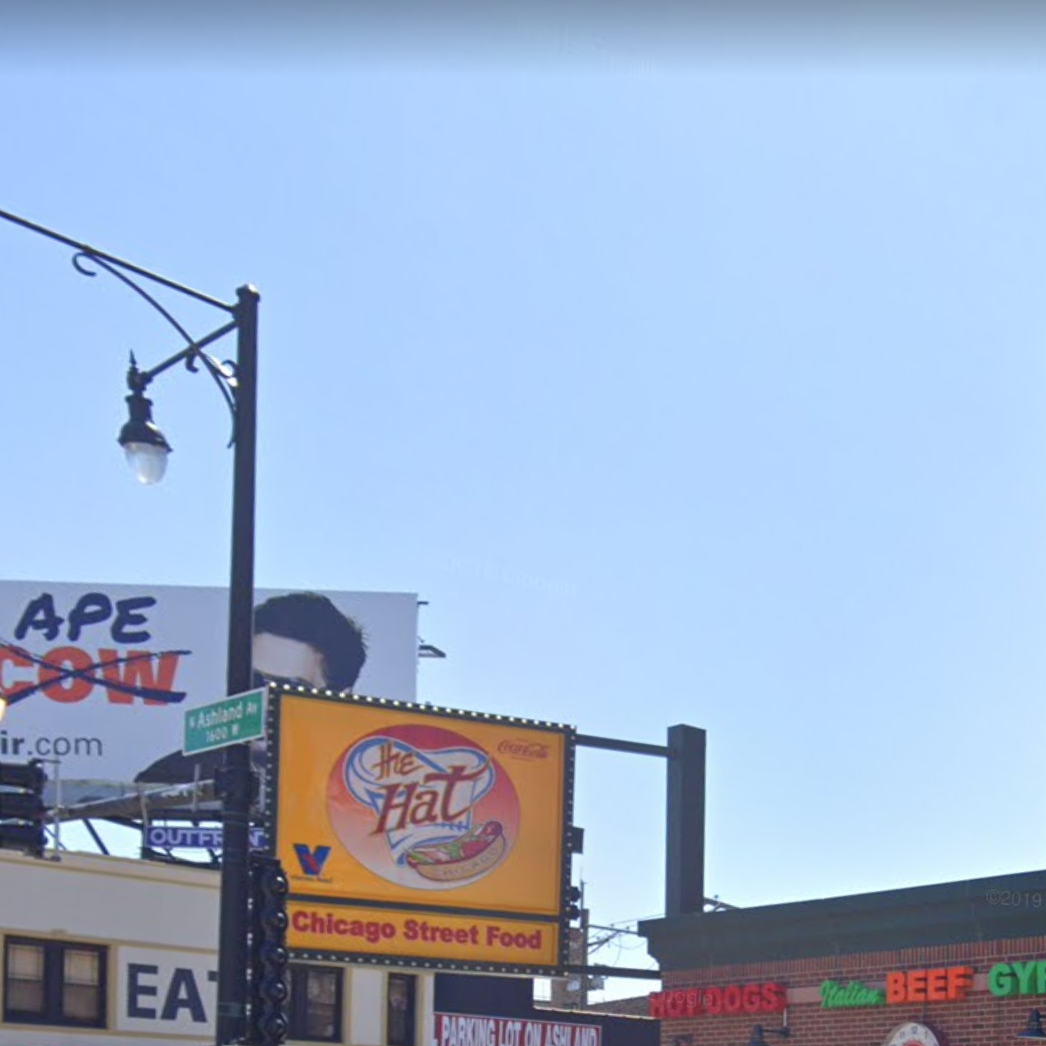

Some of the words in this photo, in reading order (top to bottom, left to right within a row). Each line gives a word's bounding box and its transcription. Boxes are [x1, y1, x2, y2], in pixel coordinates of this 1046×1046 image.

[15, 592, 156, 644] APE
[198, 701, 243, 727] Ashland
[0, 729, 103, 757] ir.com
[206, 727, 228, 741] 1600
[368, 755, 492, 836] Hat
[292, 910, 396, 943] Chicago
[403, 918, 478, 946] Street
[486, 926, 542, 949] Food
[127, 963, 219, 1023] EA
[649, 986, 701, 1019] HOT
[705, 980, 787, 1016] DOGS
[819, 979, 887, 1009] Italian
[886, 966, 975, 1004] BEEF
